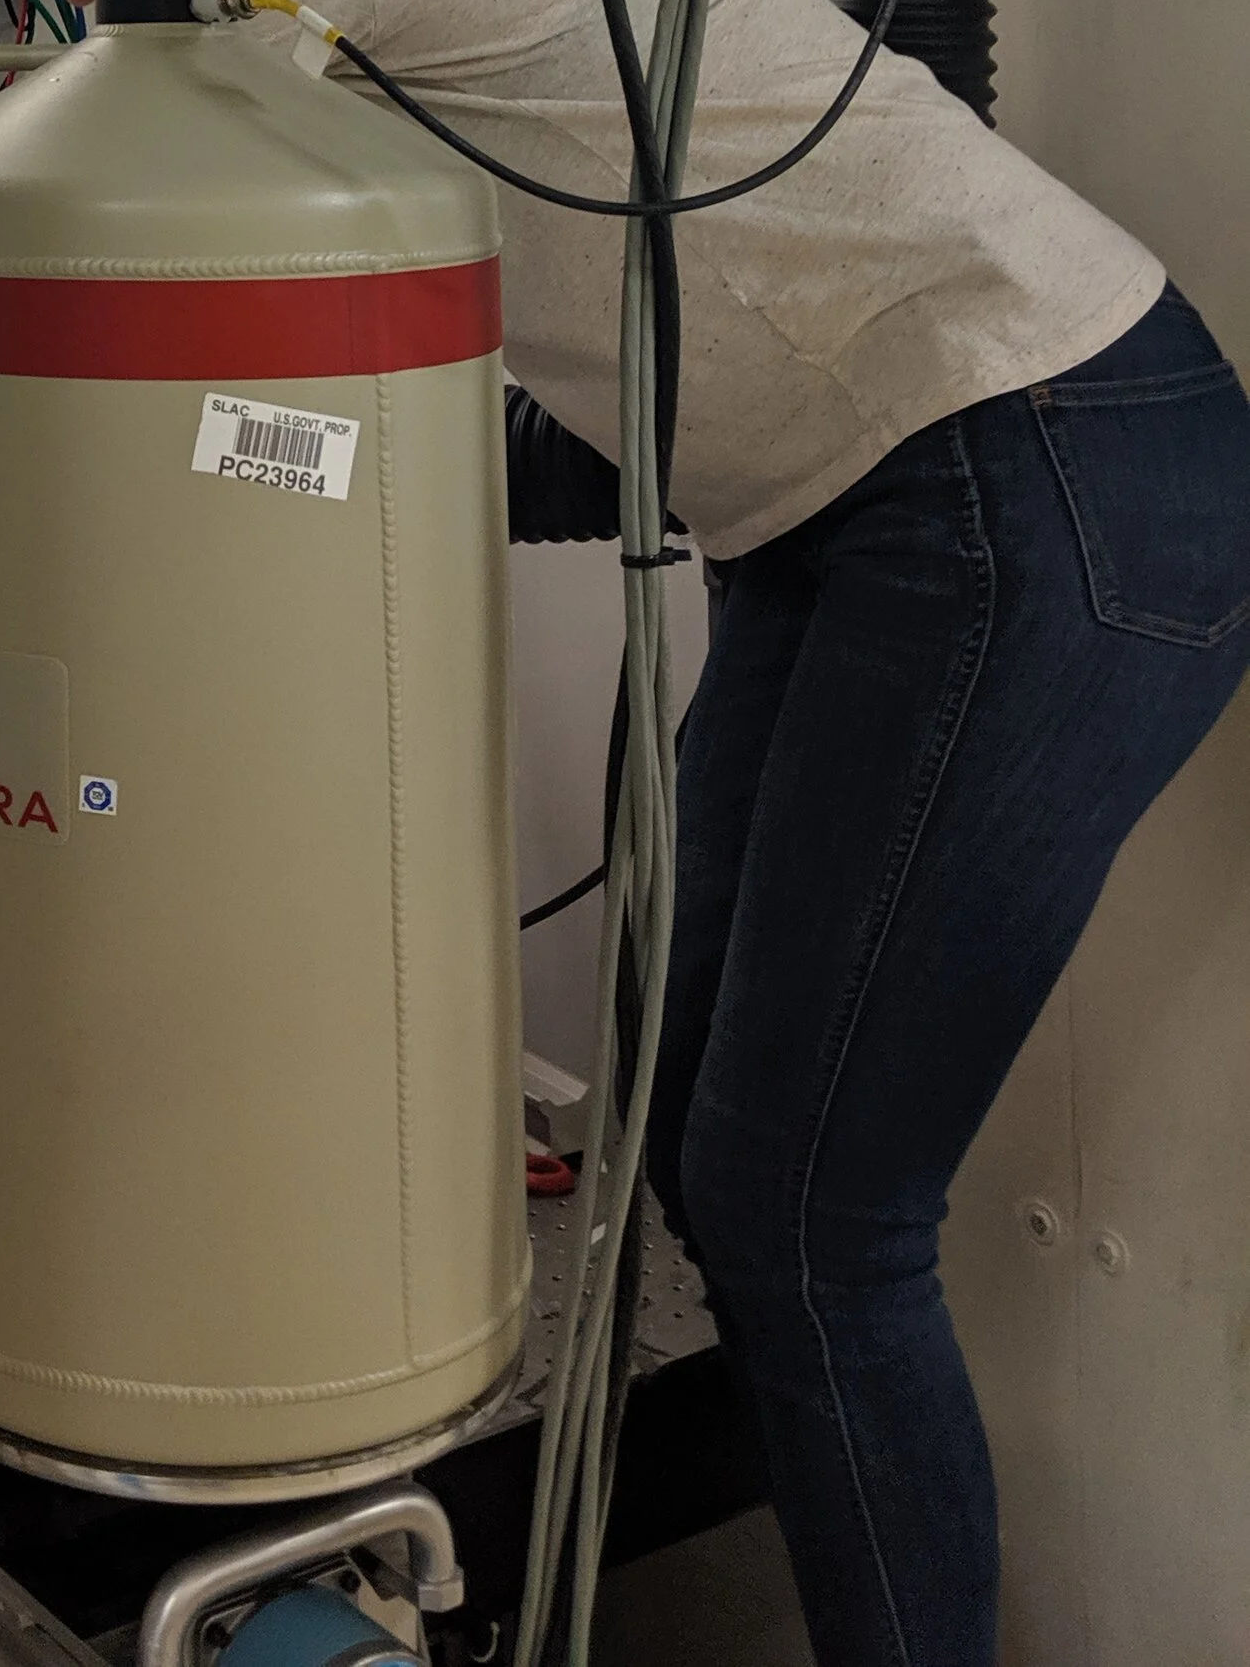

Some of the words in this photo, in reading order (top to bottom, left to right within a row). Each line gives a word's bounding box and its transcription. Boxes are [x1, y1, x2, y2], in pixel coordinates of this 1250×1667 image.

[211, 399, 250, 417] SLAC
[324, 421, 352, 437] PROP.
[218, 455, 326, 495] PC23964
